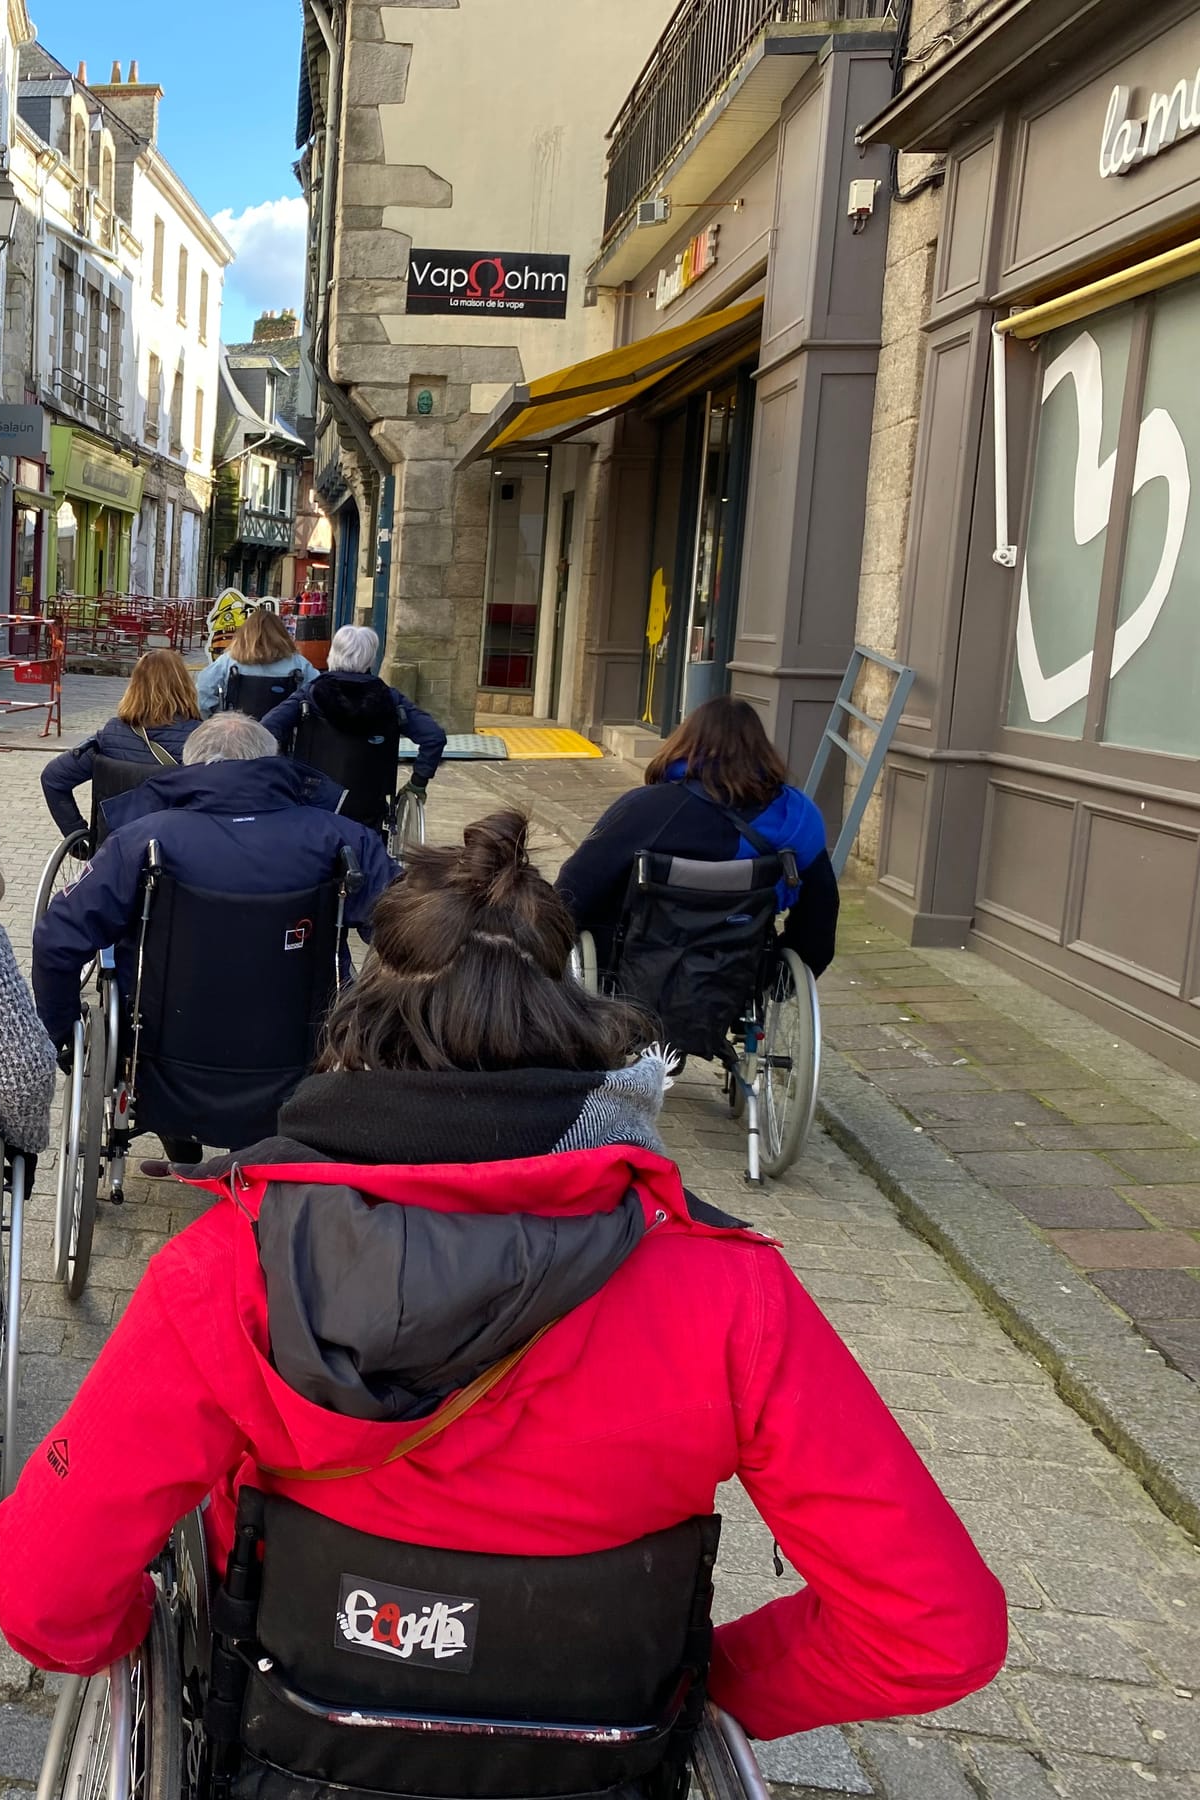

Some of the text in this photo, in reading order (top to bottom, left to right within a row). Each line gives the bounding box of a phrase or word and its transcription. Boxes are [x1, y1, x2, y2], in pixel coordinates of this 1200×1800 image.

[460, 299, 485, 308] maison
[486, 300, 497, 308] de
[497, 300, 505, 308] la
[505, 302, 525, 311] vape
